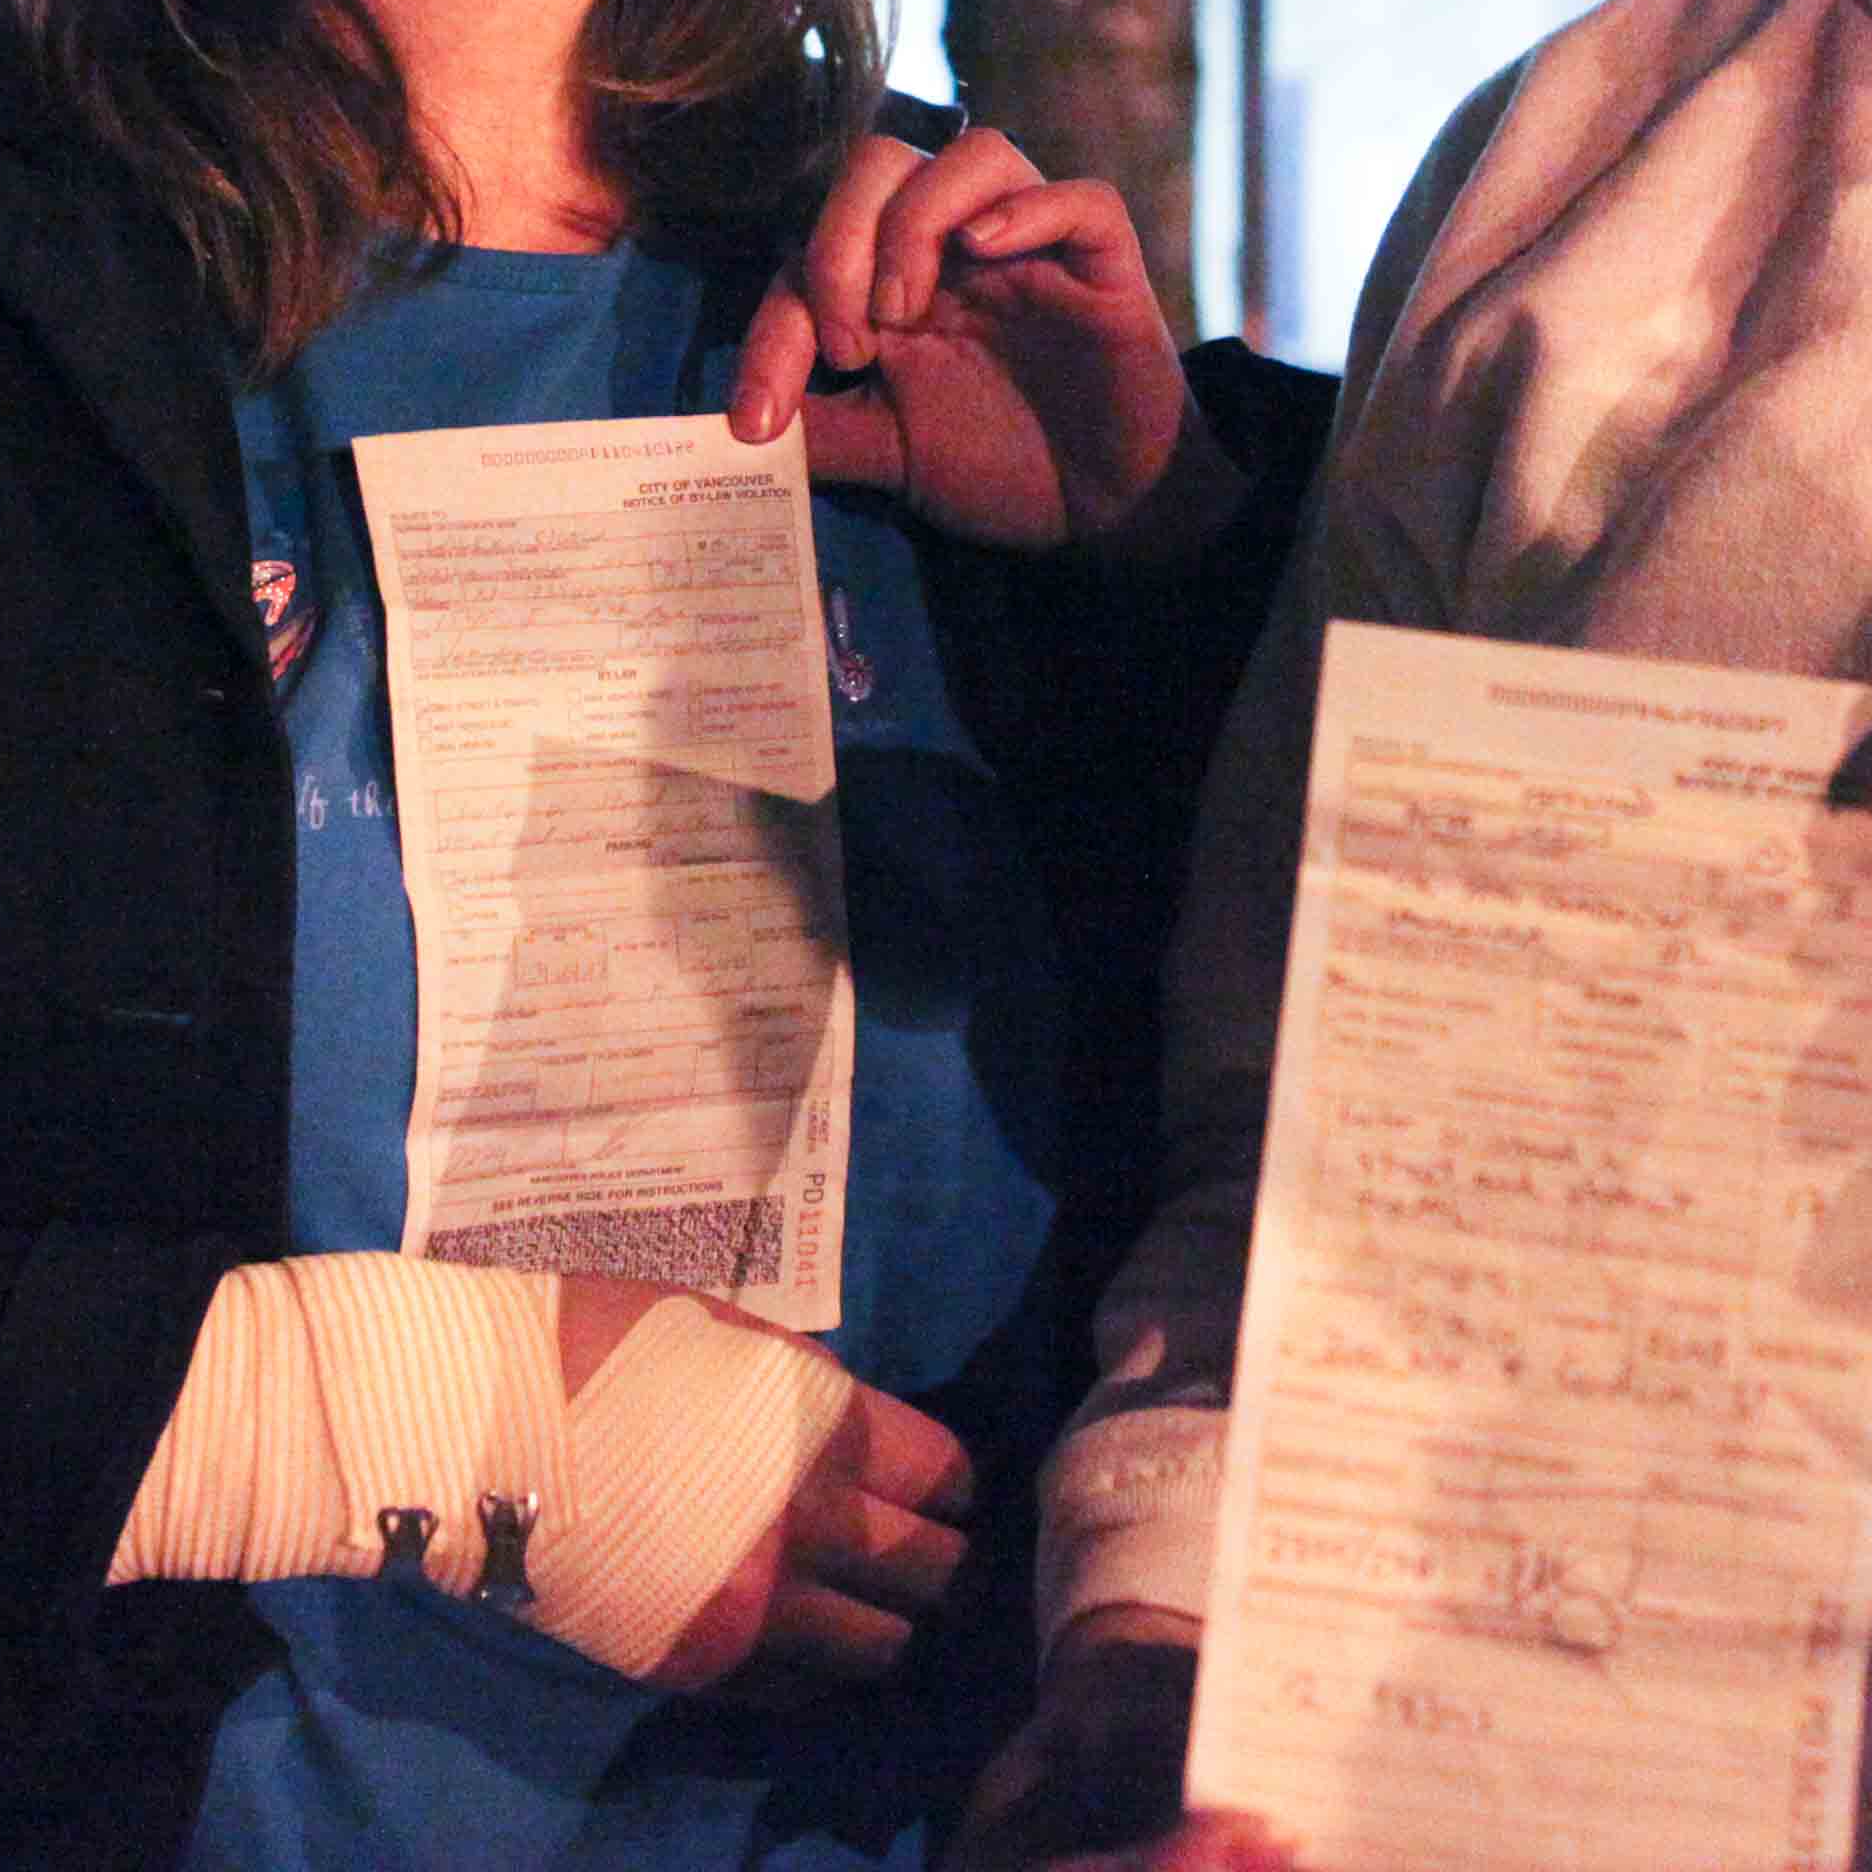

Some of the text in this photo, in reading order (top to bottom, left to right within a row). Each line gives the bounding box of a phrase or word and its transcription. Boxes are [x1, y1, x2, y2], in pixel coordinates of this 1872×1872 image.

[639, 473, 775, 495] CITY OF VANCOUVER
[635, 1180, 724, 1199] INSTRUCTIONS
